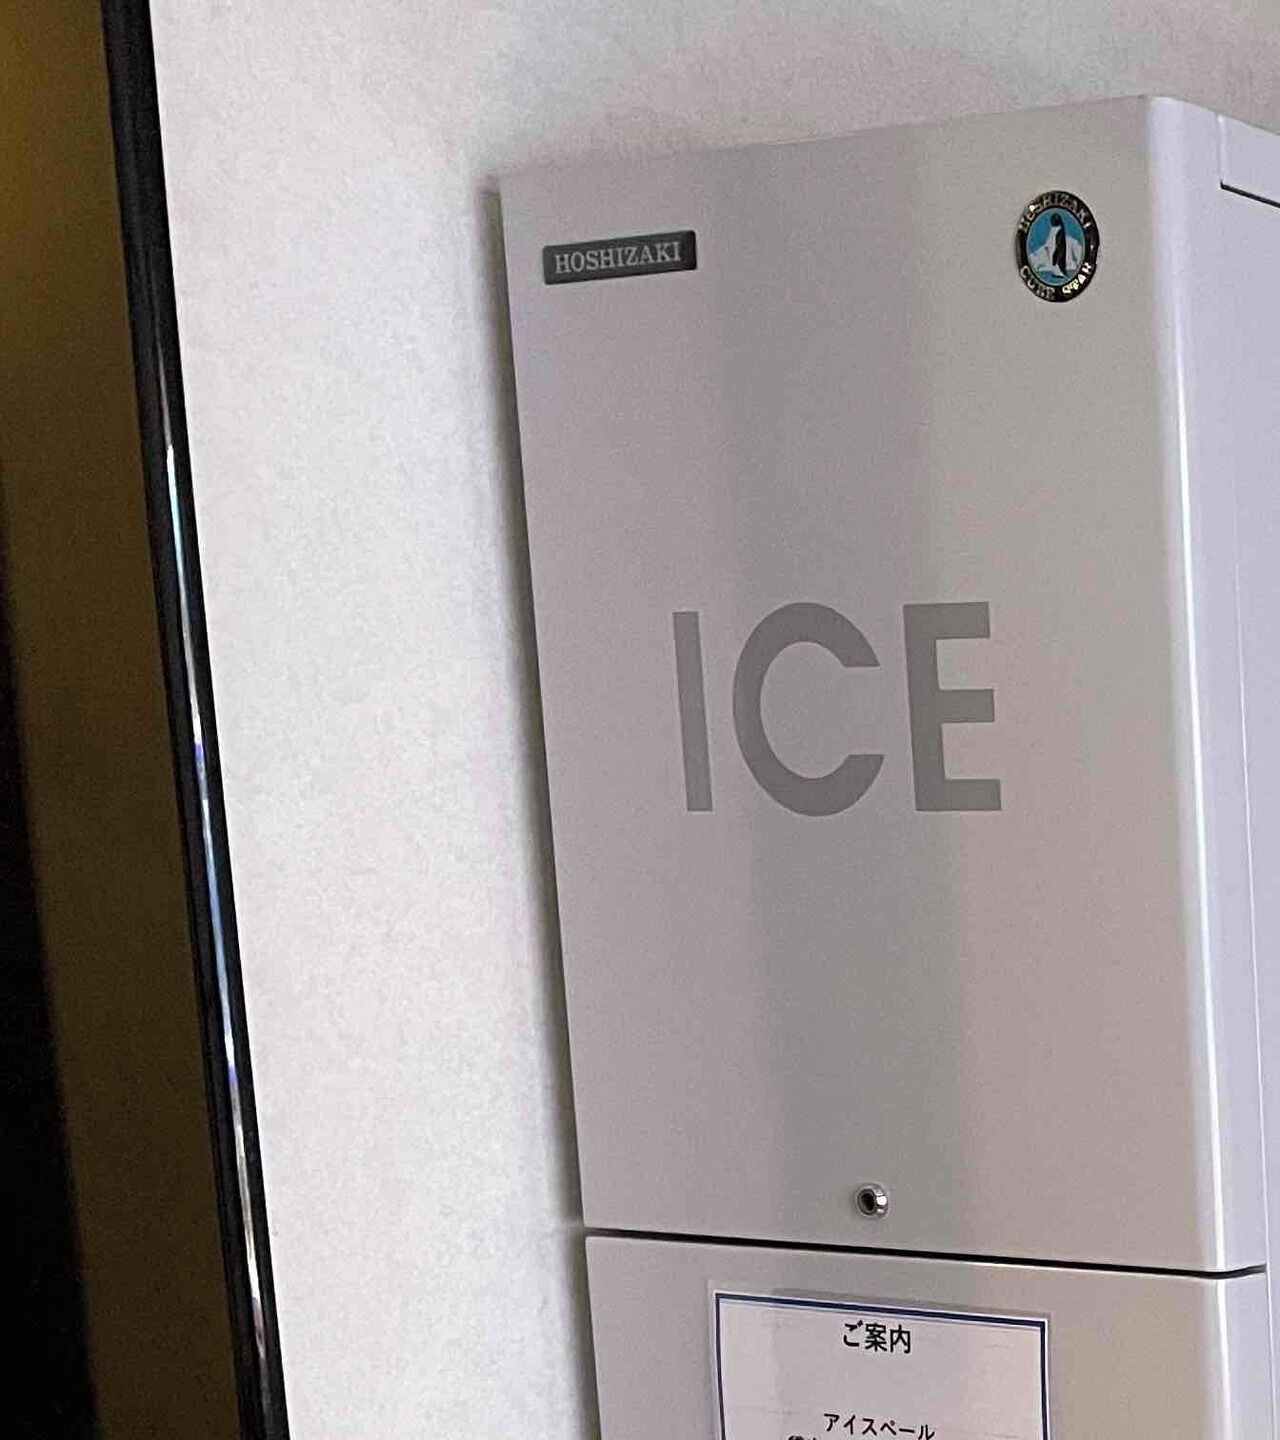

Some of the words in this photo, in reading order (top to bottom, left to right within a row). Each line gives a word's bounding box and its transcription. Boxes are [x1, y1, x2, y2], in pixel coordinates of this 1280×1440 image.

[554, 239, 682, 275] HOSHIZAKI
[672, 601, 1002, 818] ICE
[843, 1320, 911, 1353] ご案内
